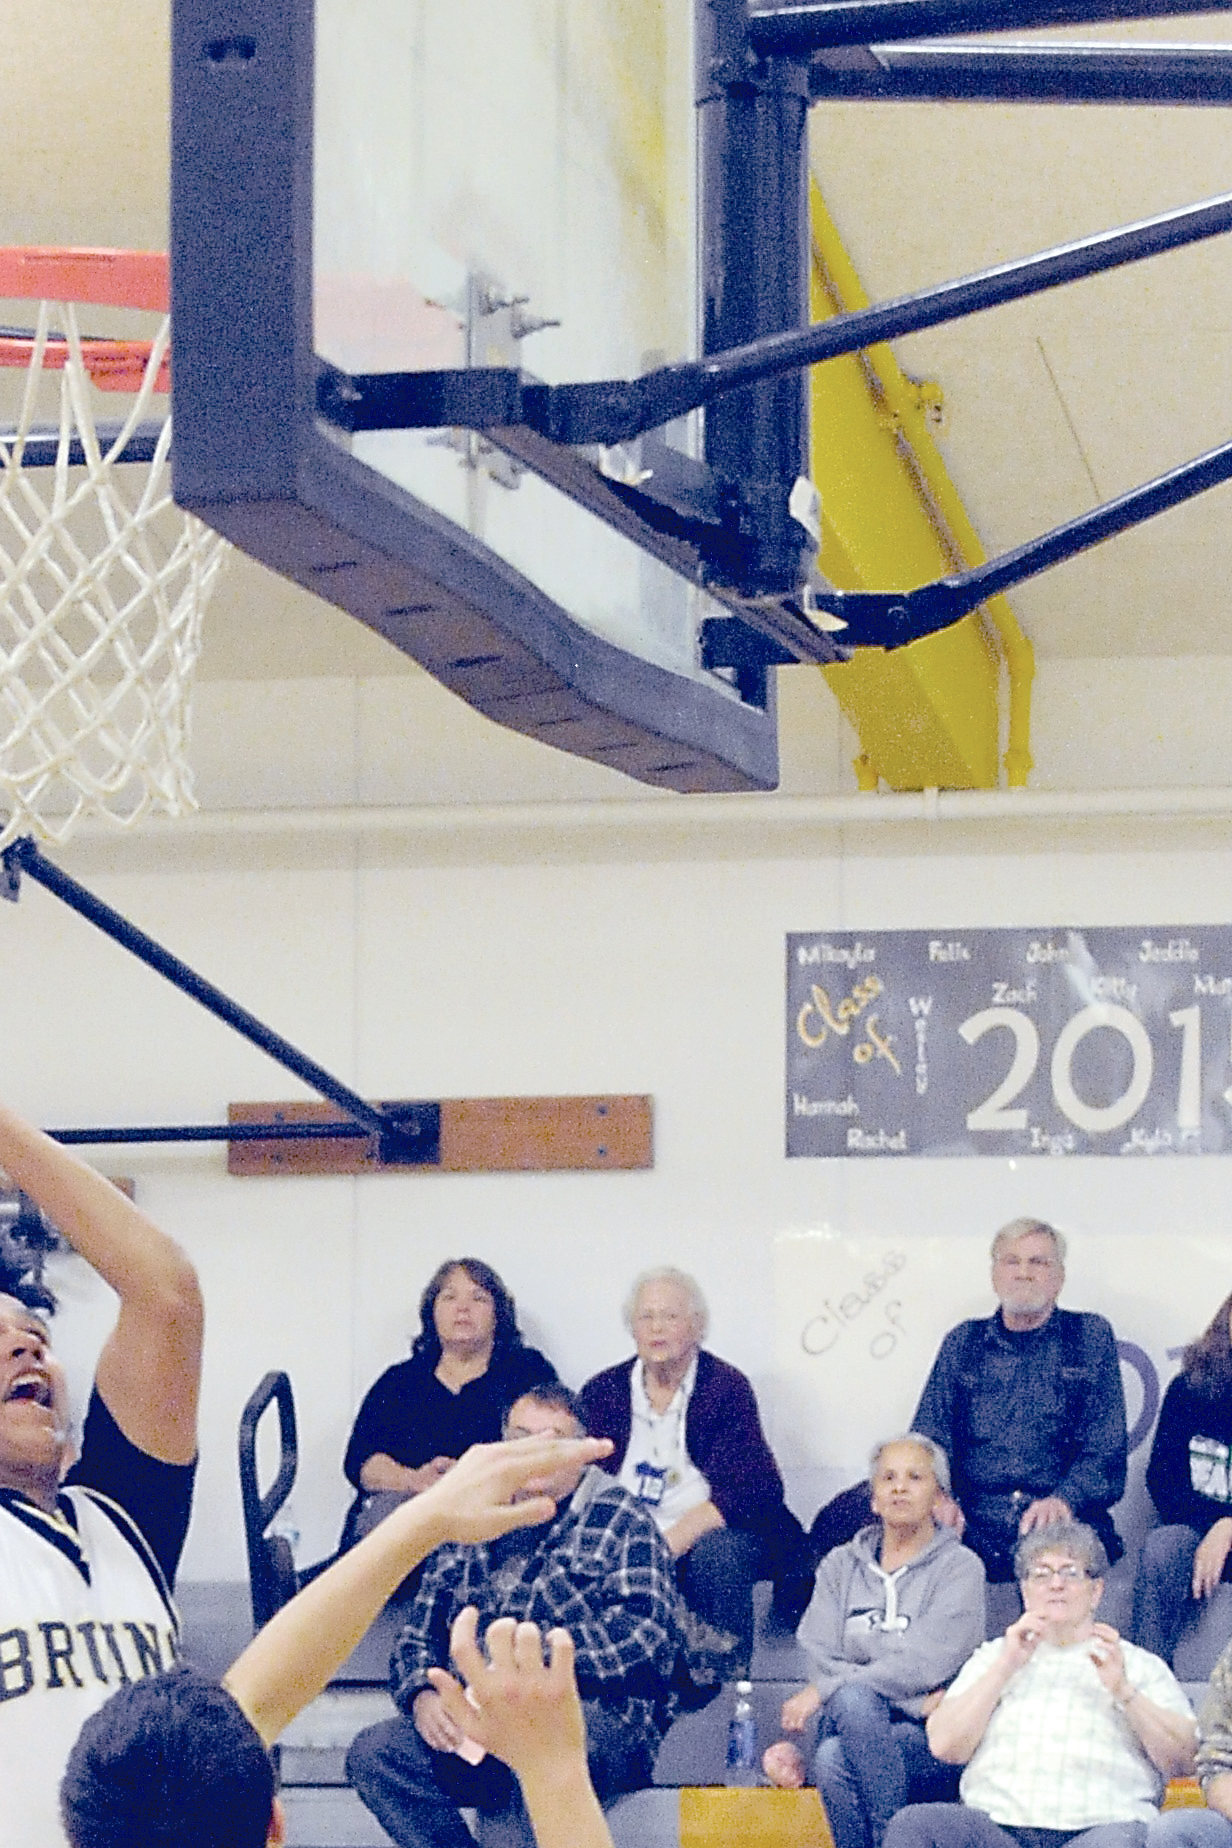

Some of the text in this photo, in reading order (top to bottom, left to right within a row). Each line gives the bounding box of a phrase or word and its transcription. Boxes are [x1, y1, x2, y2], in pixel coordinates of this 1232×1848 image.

[797, 975, 883, 1048] Class
[852, 1010, 903, 1078] of
[958, 1003, 1232, 1132] 201
[801, 1251, 907, 1356] Class
[869, 1300, 907, 1361] of
